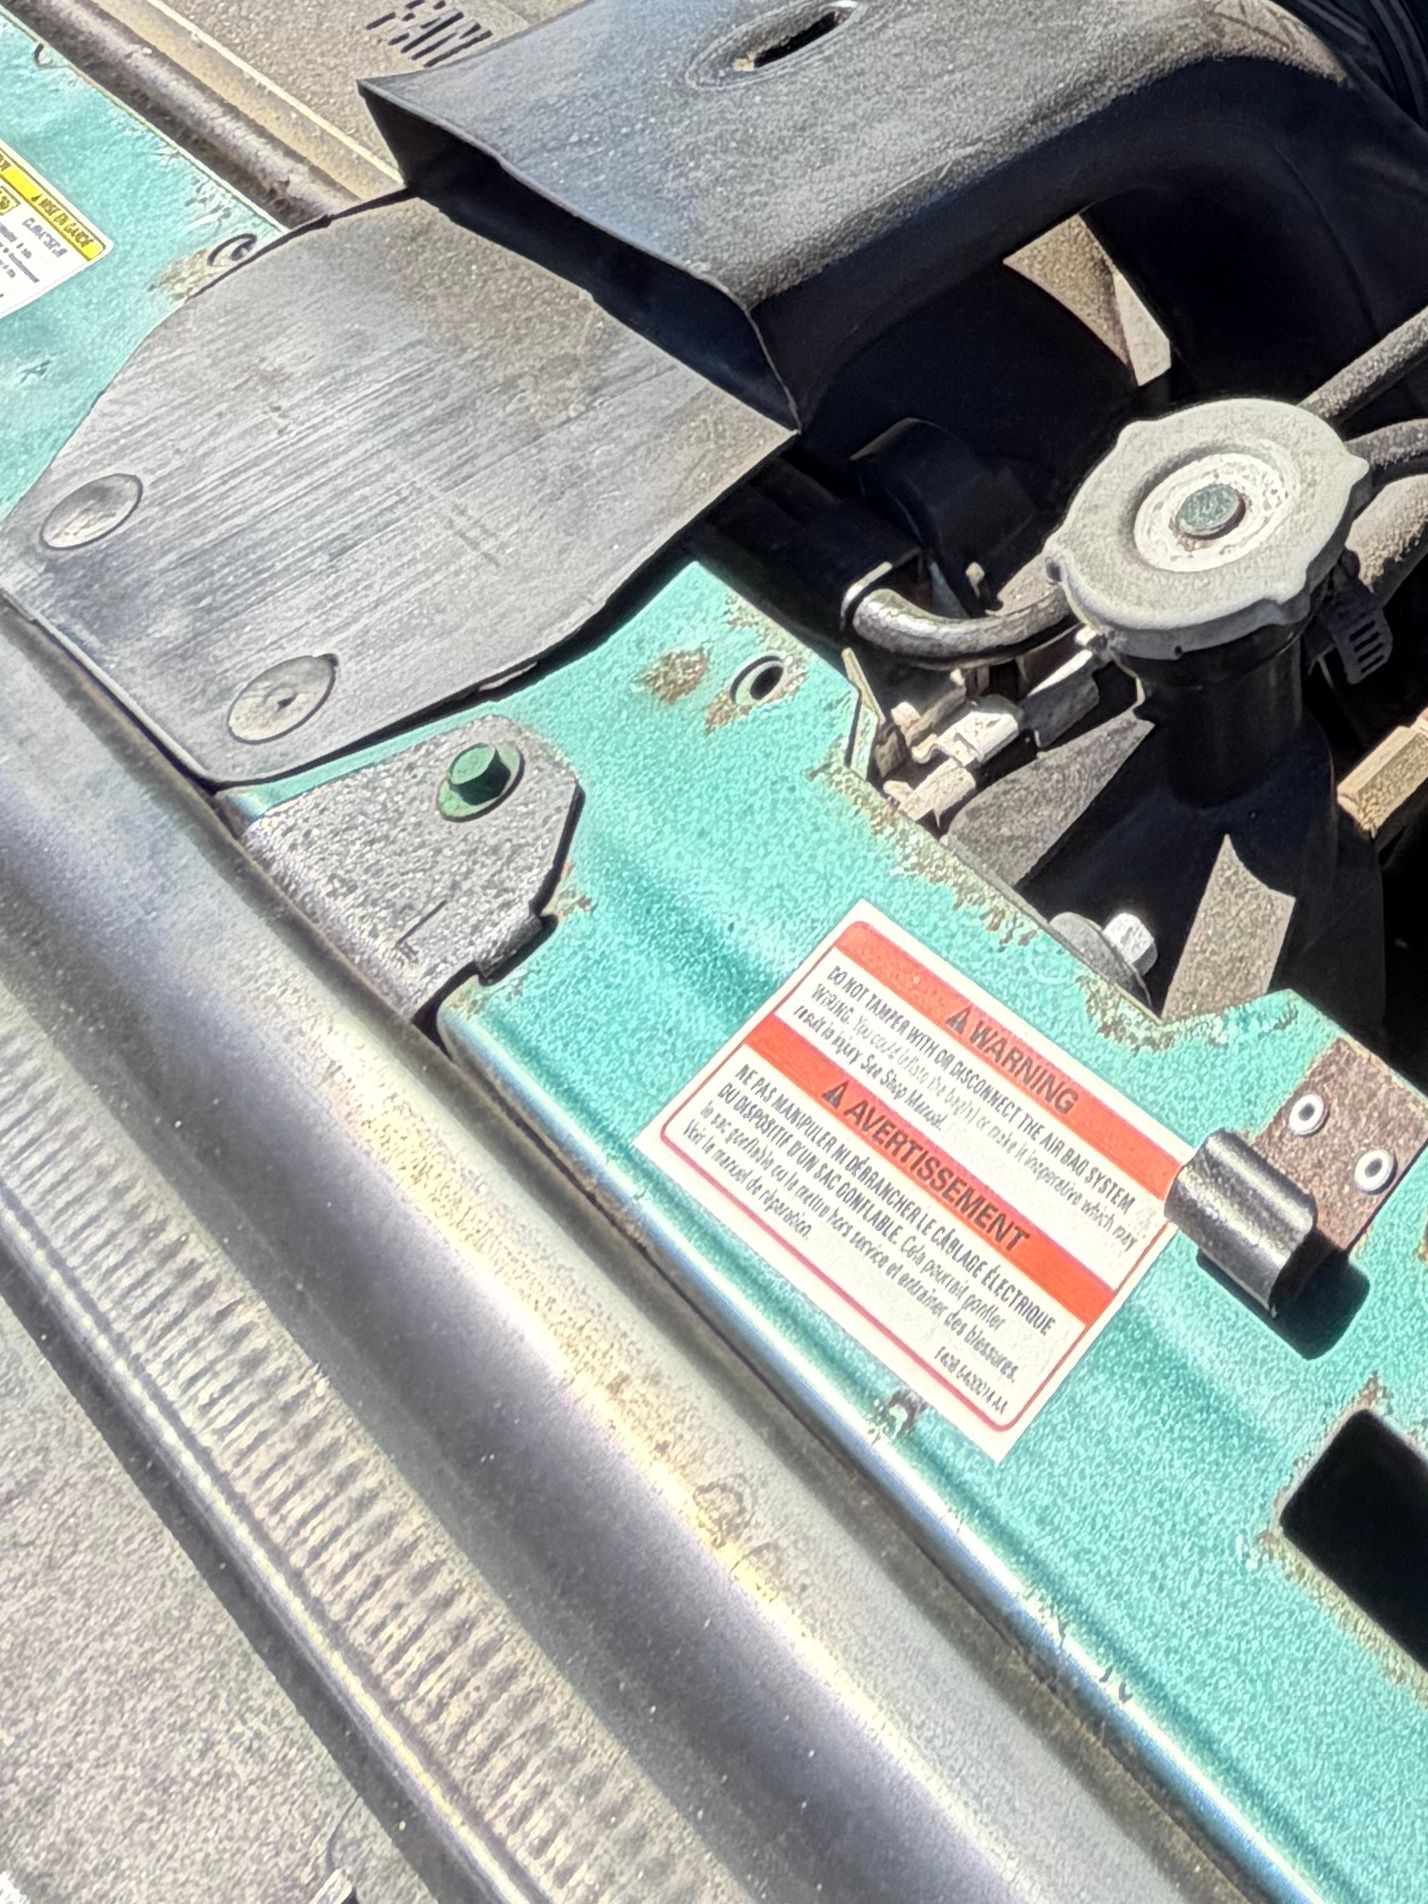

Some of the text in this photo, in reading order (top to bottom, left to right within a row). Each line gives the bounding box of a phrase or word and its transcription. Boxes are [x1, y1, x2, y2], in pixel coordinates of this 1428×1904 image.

[827, 966, 1135, 1214] DO NOT TAMPER WITH OR DISCONNECT THE AIR BAG SYSTEM
[860, 1054, 882, 1079] See
[969, 1020, 1079, 1119] WARNING
[717, 1083, 740, 1104] DU
[733, 1096, 793, 1148] DISPOSITIF
[814, 1163, 842, 1190] SAC
[735, 1064, 758, 1085] NE
[751, 1077, 777, 1102] PAS
[771, 1094, 837, 1153] MANIPULER
[831, 1144, 851, 1164] NI
[916, 1213, 936, 1235] LE
[981, 1265, 1055, 1336] ÉLECTRIQUE
[843, 1099, 1031, 1251] AVERTISSEMENT
